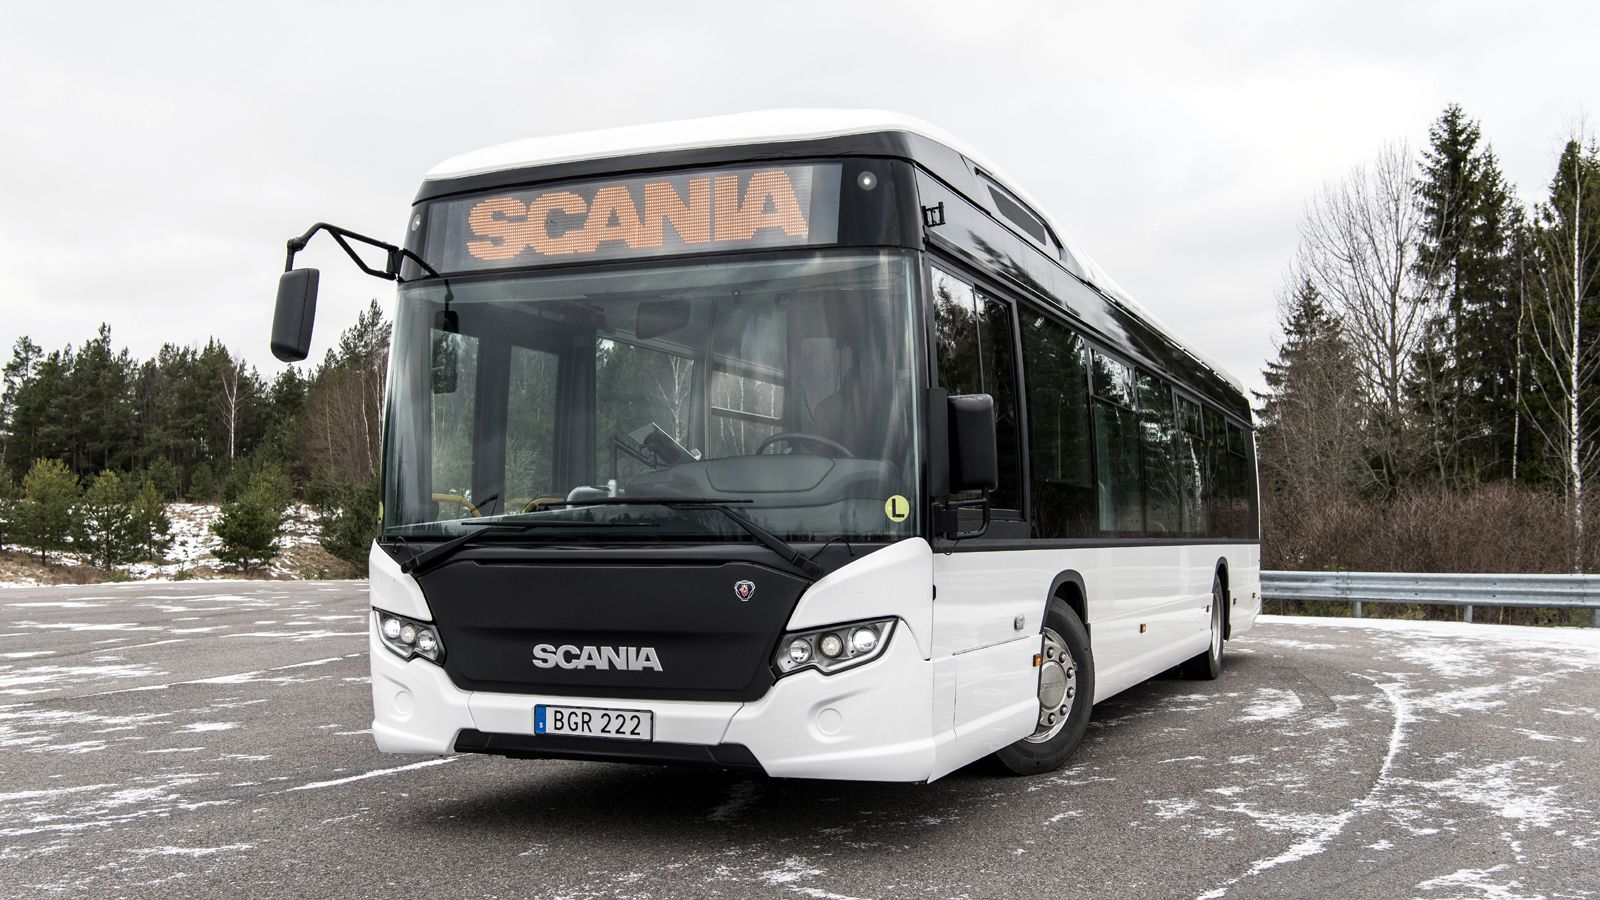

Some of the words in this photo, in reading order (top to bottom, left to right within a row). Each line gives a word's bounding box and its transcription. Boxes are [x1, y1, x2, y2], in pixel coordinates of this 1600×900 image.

[467, 171, 809, 260] SCANIA
[892, 498, 905, 517] L
[532, 643, 663, 671] SCANIA
[554, 710, 592, 733] BGR
[600, 713, 641, 736] 222
